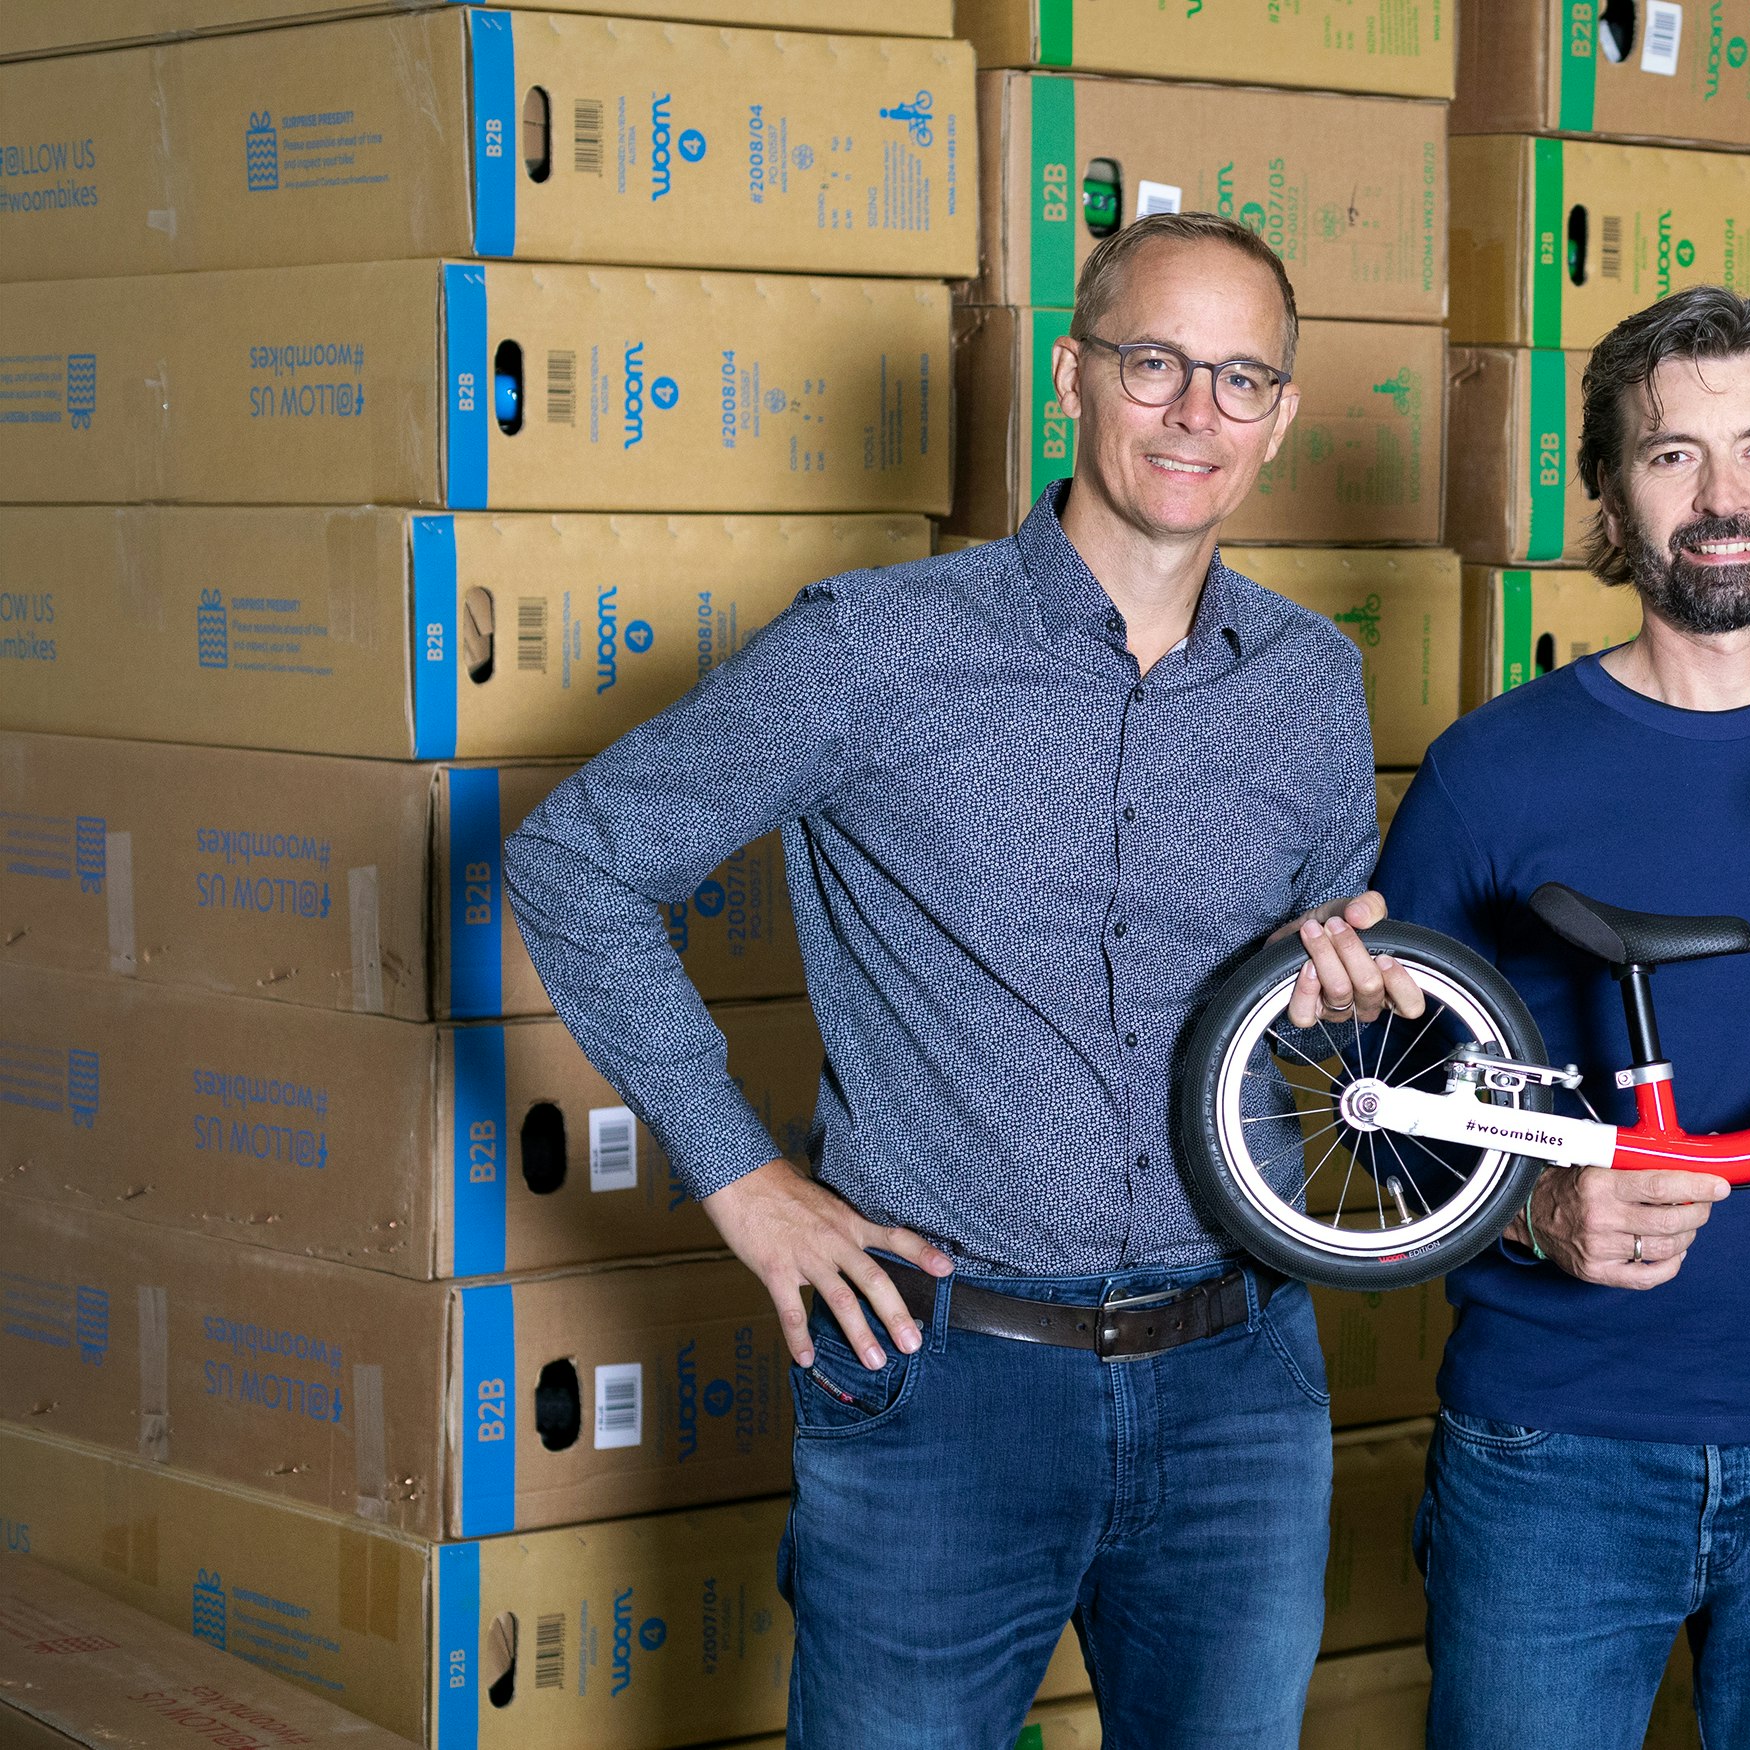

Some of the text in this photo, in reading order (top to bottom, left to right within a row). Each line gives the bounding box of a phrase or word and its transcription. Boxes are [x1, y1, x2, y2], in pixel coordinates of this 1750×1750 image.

[1570, 2, 1592, 58] B2B
[71, 138, 96, 170] US
[486, 118, 503, 158] B2B
[749, 104, 764, 204] #2008/04
[1043, 162, 1067, 223] B2B
[1267, 157, 1285, 262] 2007/05
[1541, 231, 1555, 265] B2B
[250, 343, 365, 376] #woombikes
[250, 385, 276, 418] US
[458, 372, 476, 412] B2B
[721, 350, 736, 449] #2008/04
[1538, 430, 1559, 487] B2B
[31, 592, 55, 624] US
[426, 622, 444, 662] B2B
[196, 827, 332, 871] #woombikes
[196, 872, 226, 909] US
[465, 862, 492, 926] B2B
[193, 1068, 329, 1122] #woombikes
[193, 1114, 222, 1152] US
[469, 1119, 497, 1184] B2B
[1465, 1118, 1565, 1147] #woombikes
[1408, 1240, 1441, 1258] EDITION
[204, 1314, 343, 1377] #woombikes
[204, 1359, 233, 1397] US
[477, 1377, 506, 1443] B2B
[6, 1524, 31, 1554] US
[449, 1647, 467, 1689] B2B
